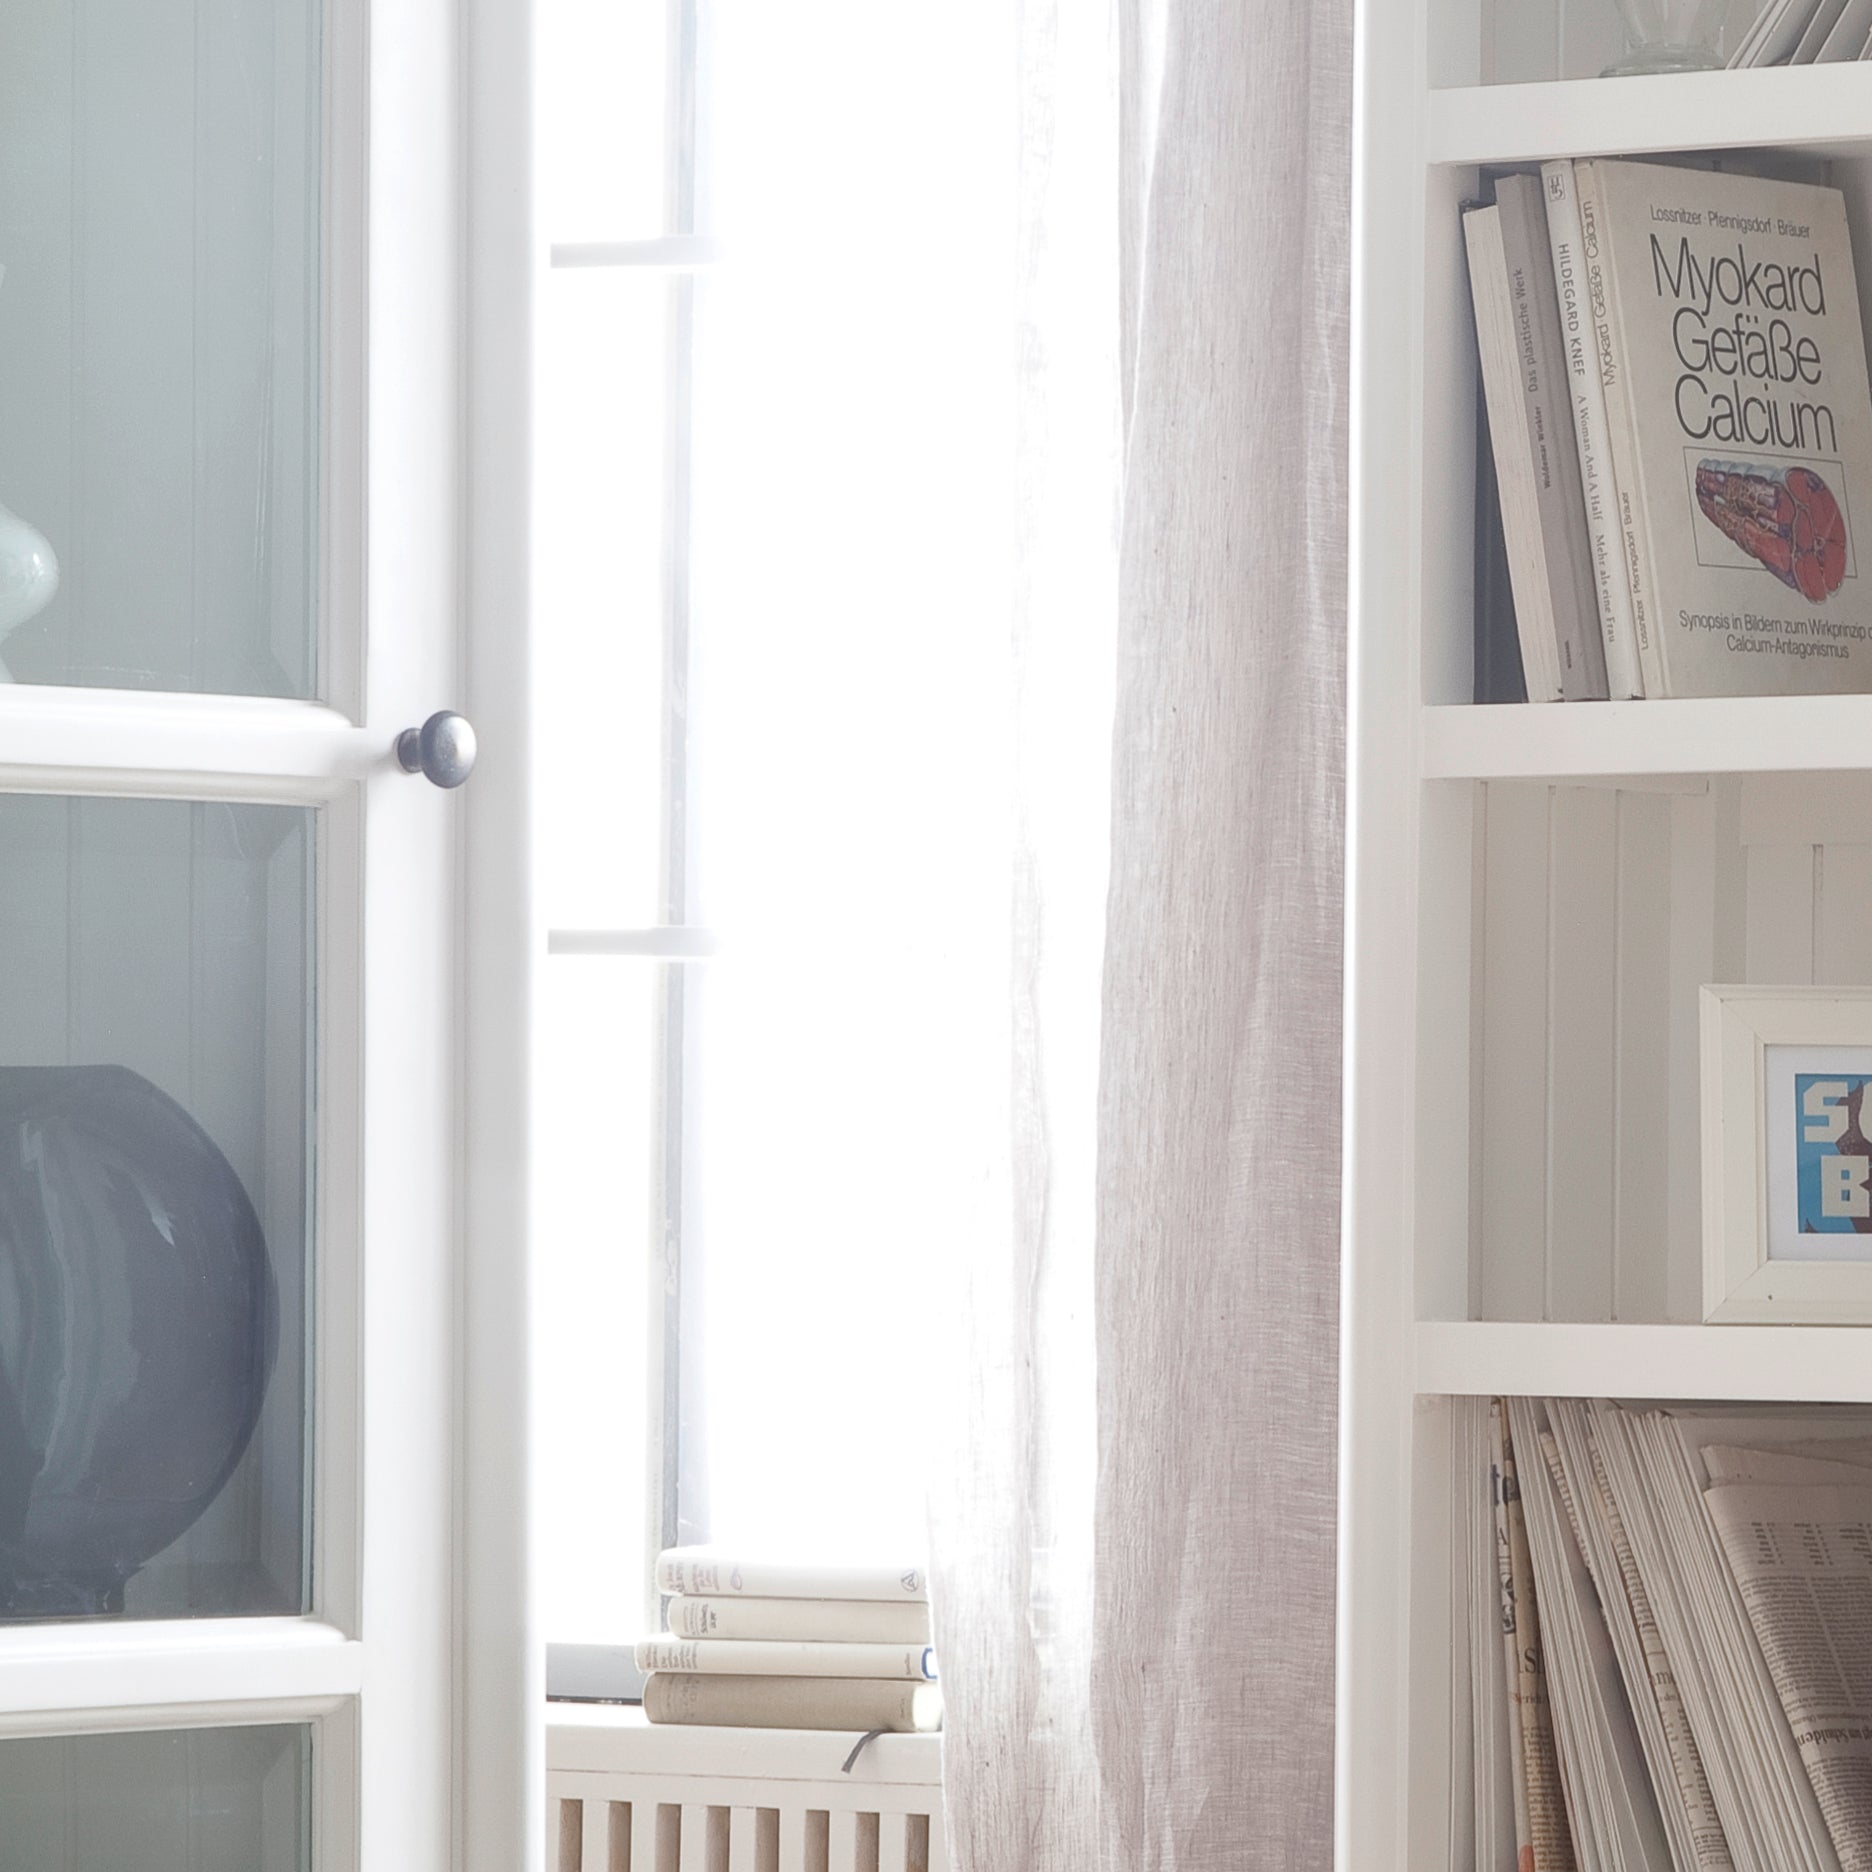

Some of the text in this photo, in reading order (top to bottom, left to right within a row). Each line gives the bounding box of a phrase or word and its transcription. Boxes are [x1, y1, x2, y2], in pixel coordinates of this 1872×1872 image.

[1650, 204, 1810, 238] Lossnitzer Pfennigsdorf Bräuer
[1557, 243, 1585, 376] HILDEGARD KNEF
[1650, 233, 1826, 317] Myokard
[1509, 267, 1539, 392] Das plastische Werk
[1673, 307, 1822, 385] Gefäße
[1675, 374, 1837, 452] Calcium
[1576, 394, 1602, 521] A Woman And A Half
[1594, 533, 1617, 643] Mehr als eine Frau
[1679, 609, 1730, 631] Synopsis
[1732, 614, 1743, 629] in
[1745, 614, 1783, 633] Bildern
[1784, 621, 1808, 635] zum
[1808, 619, 1866, 642] Wirkprinzip
[1727, 634, 1849, 659] Calcium-Antagonismus
